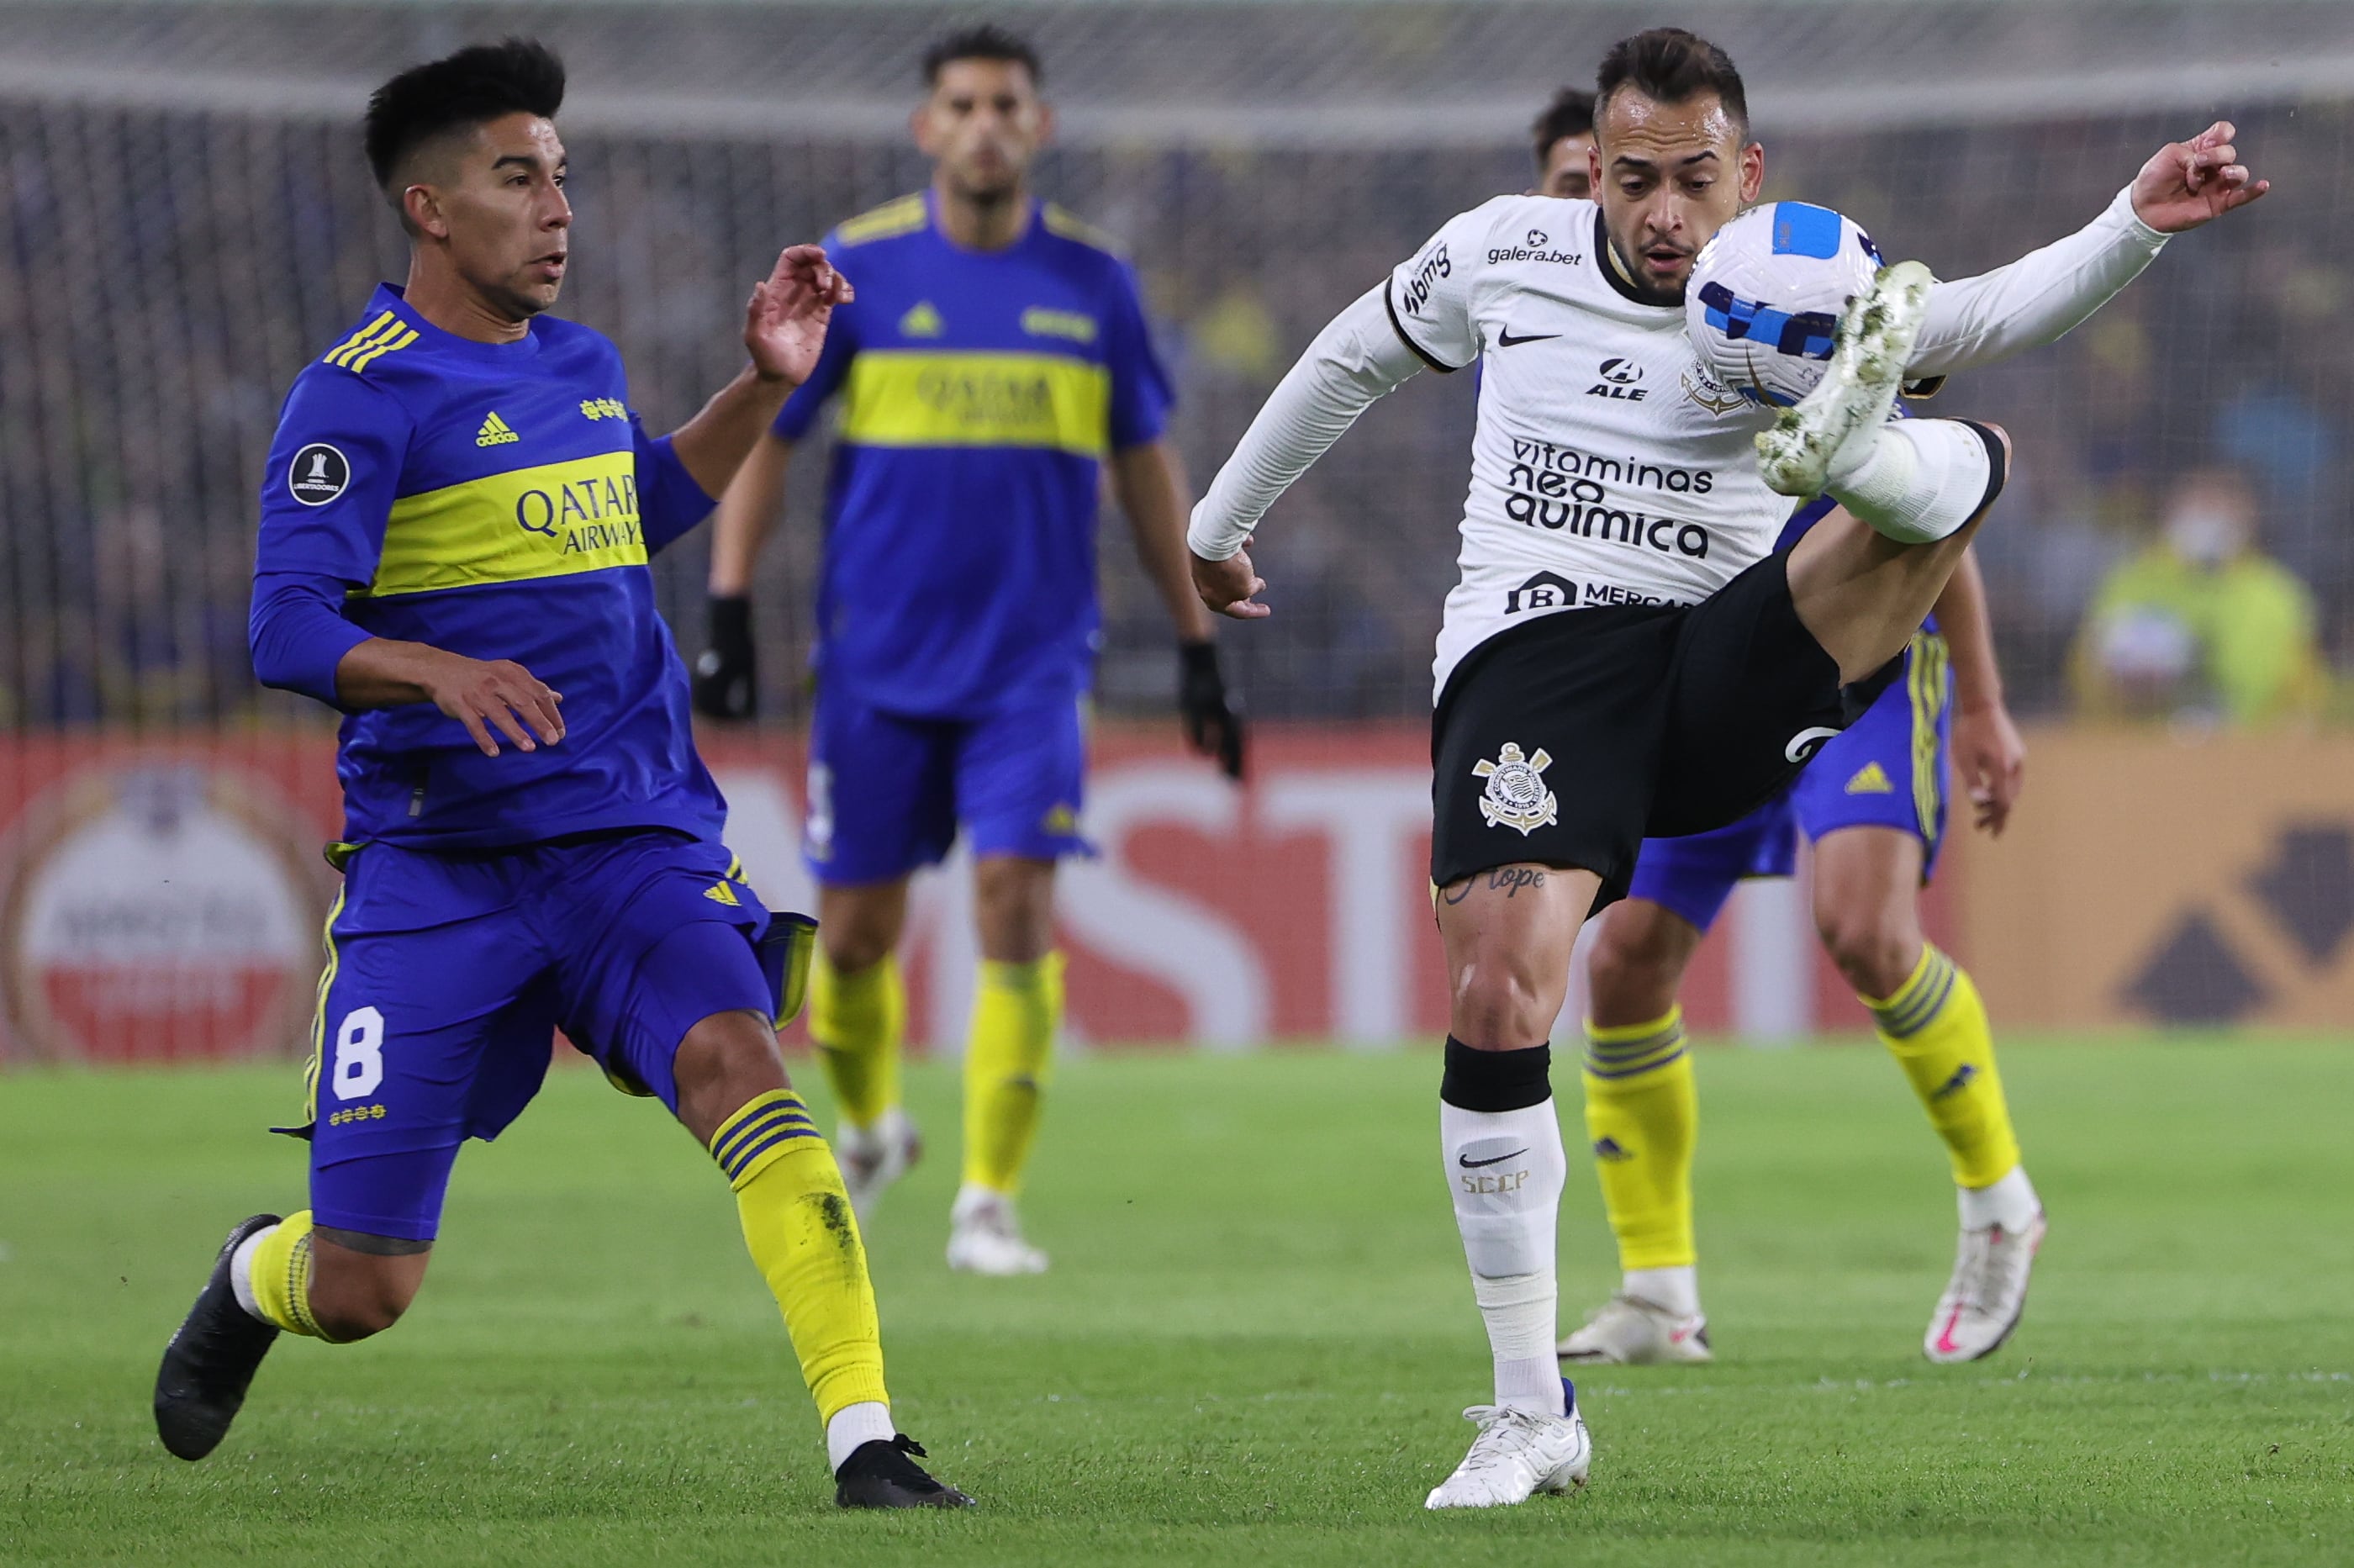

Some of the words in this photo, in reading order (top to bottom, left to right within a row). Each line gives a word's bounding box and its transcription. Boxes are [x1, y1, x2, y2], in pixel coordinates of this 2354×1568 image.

[1410, 243, 1451, 304] bmg
[1487, 245, 1582, 266] galera.bet
[1585, 383, 1649, 401] ALE
[475, 431, 520, 447] adidas
[1507, 463, 1605, 504] neo
[1512, 439, 1713, 494] vitaminas
[515, 474, 639, 538] QATAR
[332, 1006, 384, 1101] 8
